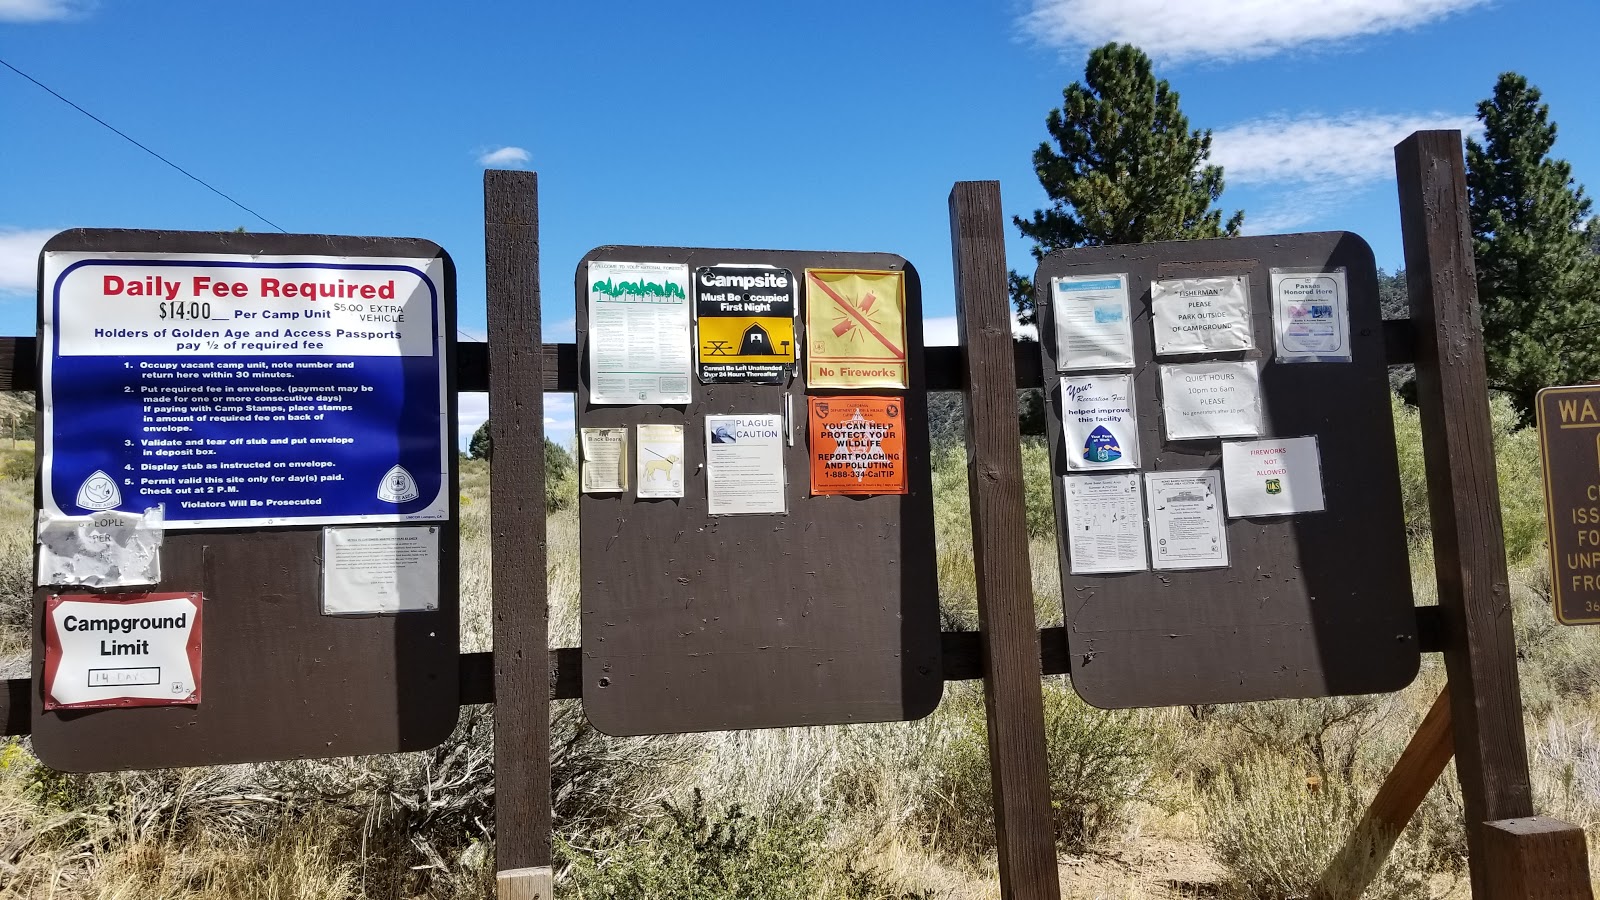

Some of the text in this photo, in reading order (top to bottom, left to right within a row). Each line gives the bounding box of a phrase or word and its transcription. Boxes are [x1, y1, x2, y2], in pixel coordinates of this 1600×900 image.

[702, 272, 787, 290] Campsite
[103, 275, 395, 302] Daily Fee Required
[702, 293, 789, 303] Must Be ccupied
[334, 303, 403, 313] $5.00 EXTRA
[720, 303, 771, 312] First Night
[234, 309, 257, 318] Per
[262, 310, 299, 320] Camp
[304, 309, 330, 318] Unit
[360, 314, 405, 322] VEHICLE
[1178, 313, 1196, 321] PARK
[1183, 323, 1232, 331] CAMPGROUND
[94, 328, 402, 340] Holders of Golden Age and Access Passports
[176, 342, 200, 351] pay
[223, 340, 237, 349] of
[241, 340, 298, 351] required
[302, 340, 323, 349] fee
[139, 361, 178, 369] Occupy
[246, 361, 268, 369] unit,
[820, 368, 896, 377] No Fireworks
[1185, 375, 1207, 383] QUIET
[160, 385, 203, 393] required
[236, 385, 284, 393] envelope.
[288, 385, 335, 393] (payment
[1066, 383, 1093, 401] Your
[1188, 387, 1208, 395] 10pm
[1111, 394, 1126, 402] Fees
[1559, 399, 1598, 422] WA
[140, 438, 182, 446] Validate
[229, 437, 244, 445] off
[246, 437, 267, 445] stub
[290, 437, 307, 445] put
[309, 436, 354, 445] envelope
[1250, 448, 1287, 456] FIREWORKS
[140, 463, 179, 471] Display
[288, 460, 335, 468] envelope.
[178, 476, 202, 484] valid
[247, 475, 268, 483] only
[287, 474, 317, 483] day(s)
[320, 473, 344, 482] paid.
[180, 500, 226, 508] Violators
[228, 499, 247, 507] Will
[266, 497, 321, 506] Prosecuted
[1572, 508, 1600, 524] ISS
[88, 519, 124, 528] EOPLE
[1578, 530, 1600, 546] FO
[64, 613, 186, 633] Campground
[101, 640, 149, 656] Limit
[96, 673, 108, 683] 14
